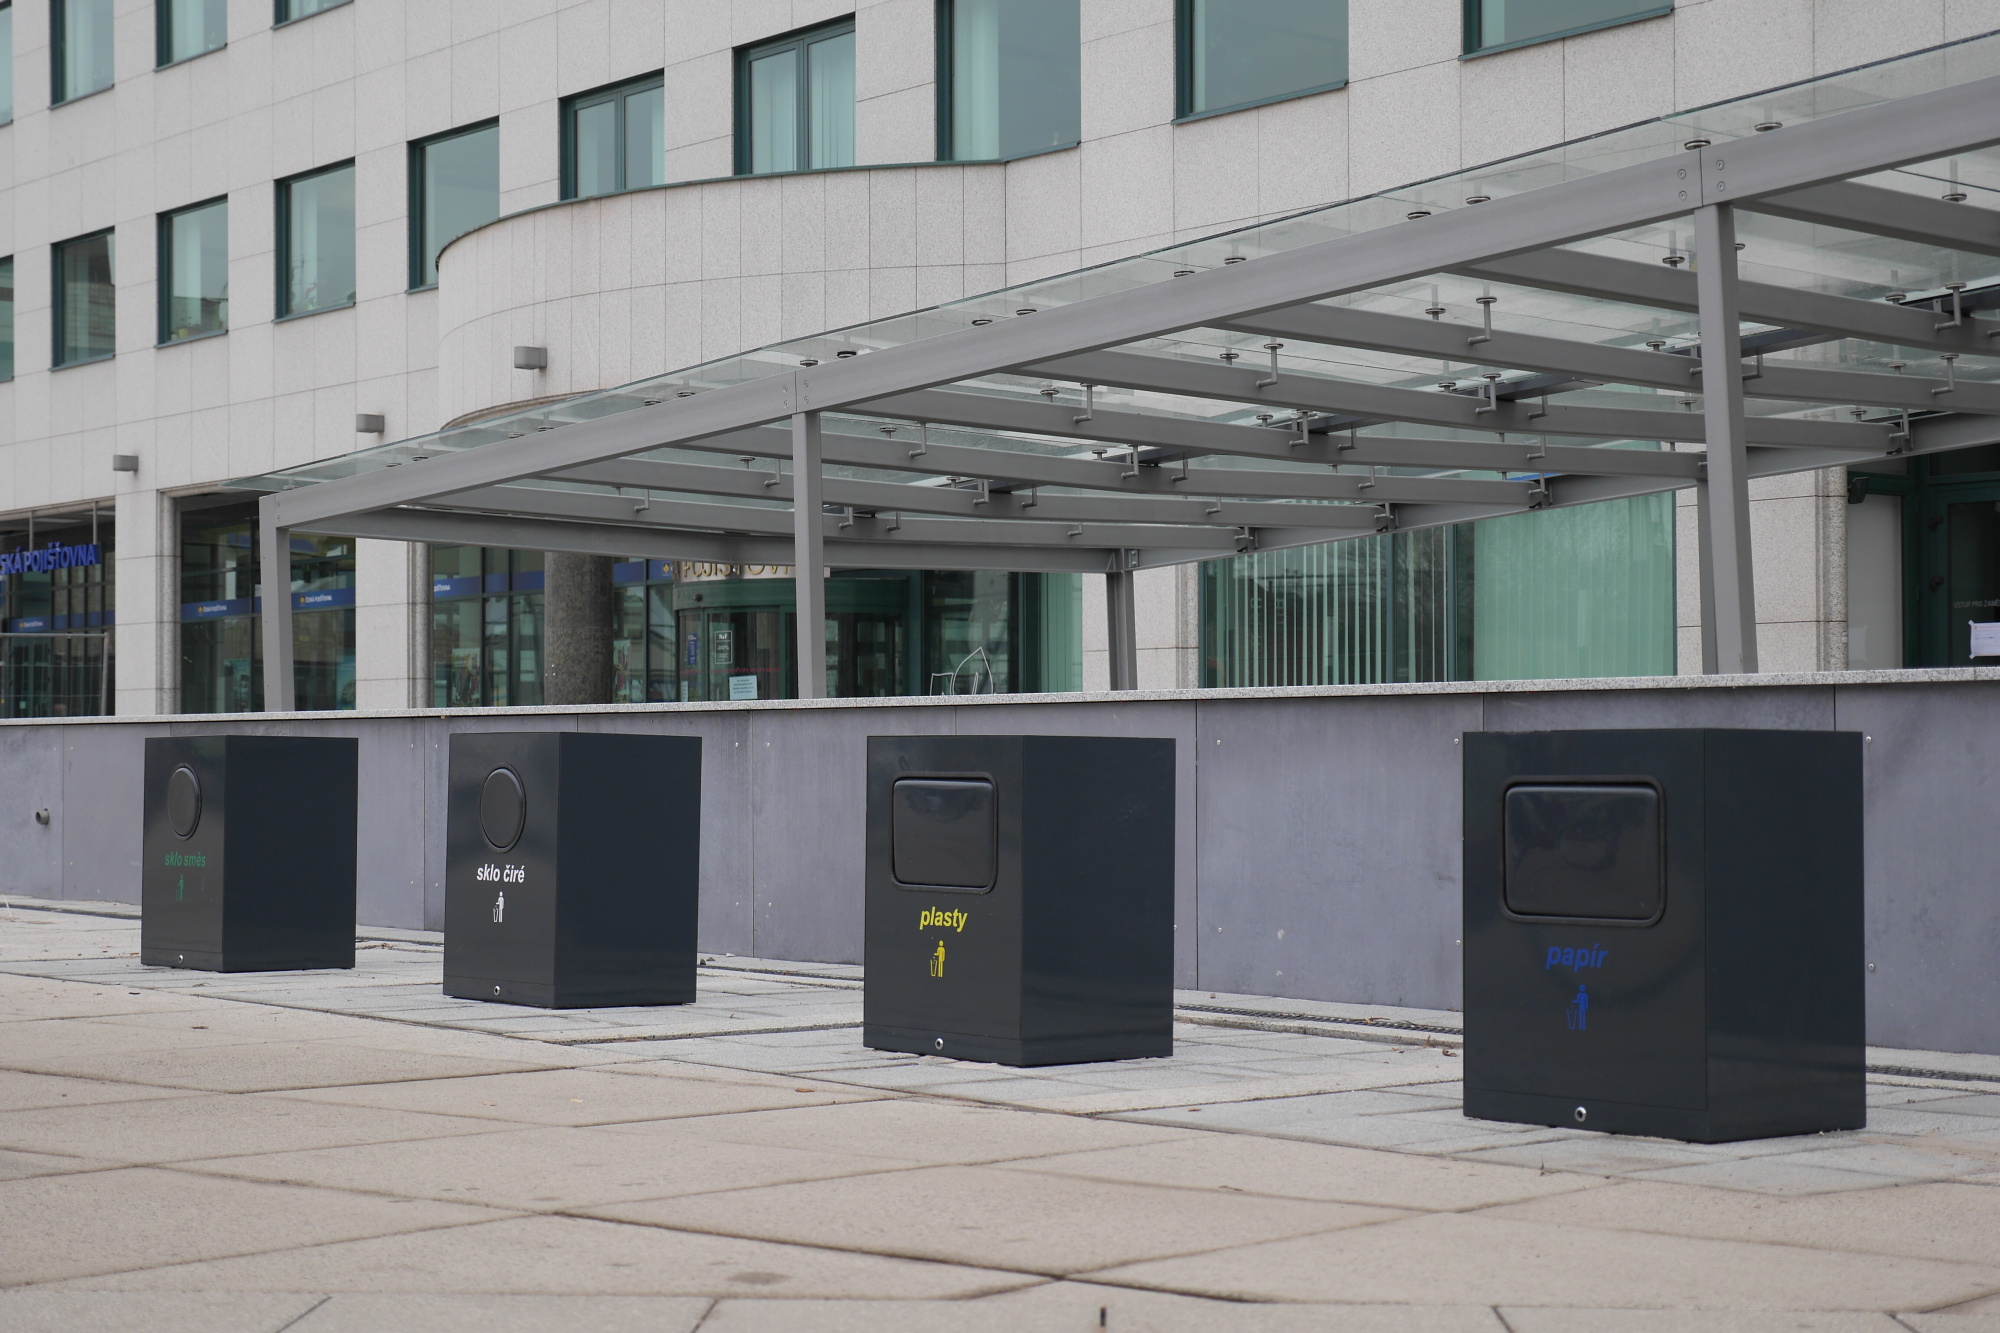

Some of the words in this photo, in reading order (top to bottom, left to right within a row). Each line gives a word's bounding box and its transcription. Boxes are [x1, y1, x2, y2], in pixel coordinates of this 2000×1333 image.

[24, 542, 97, 573] POJIŠŤOVNA
[165, 851, 183, 866] sklo
[184, 851, 206, 867] směs
[476, 863, 501, 882] sklo
[503, 864, 525, 883] čiré
[919, 906, 968, 933] plasty
[1545, 943, 1609, 973] papír
